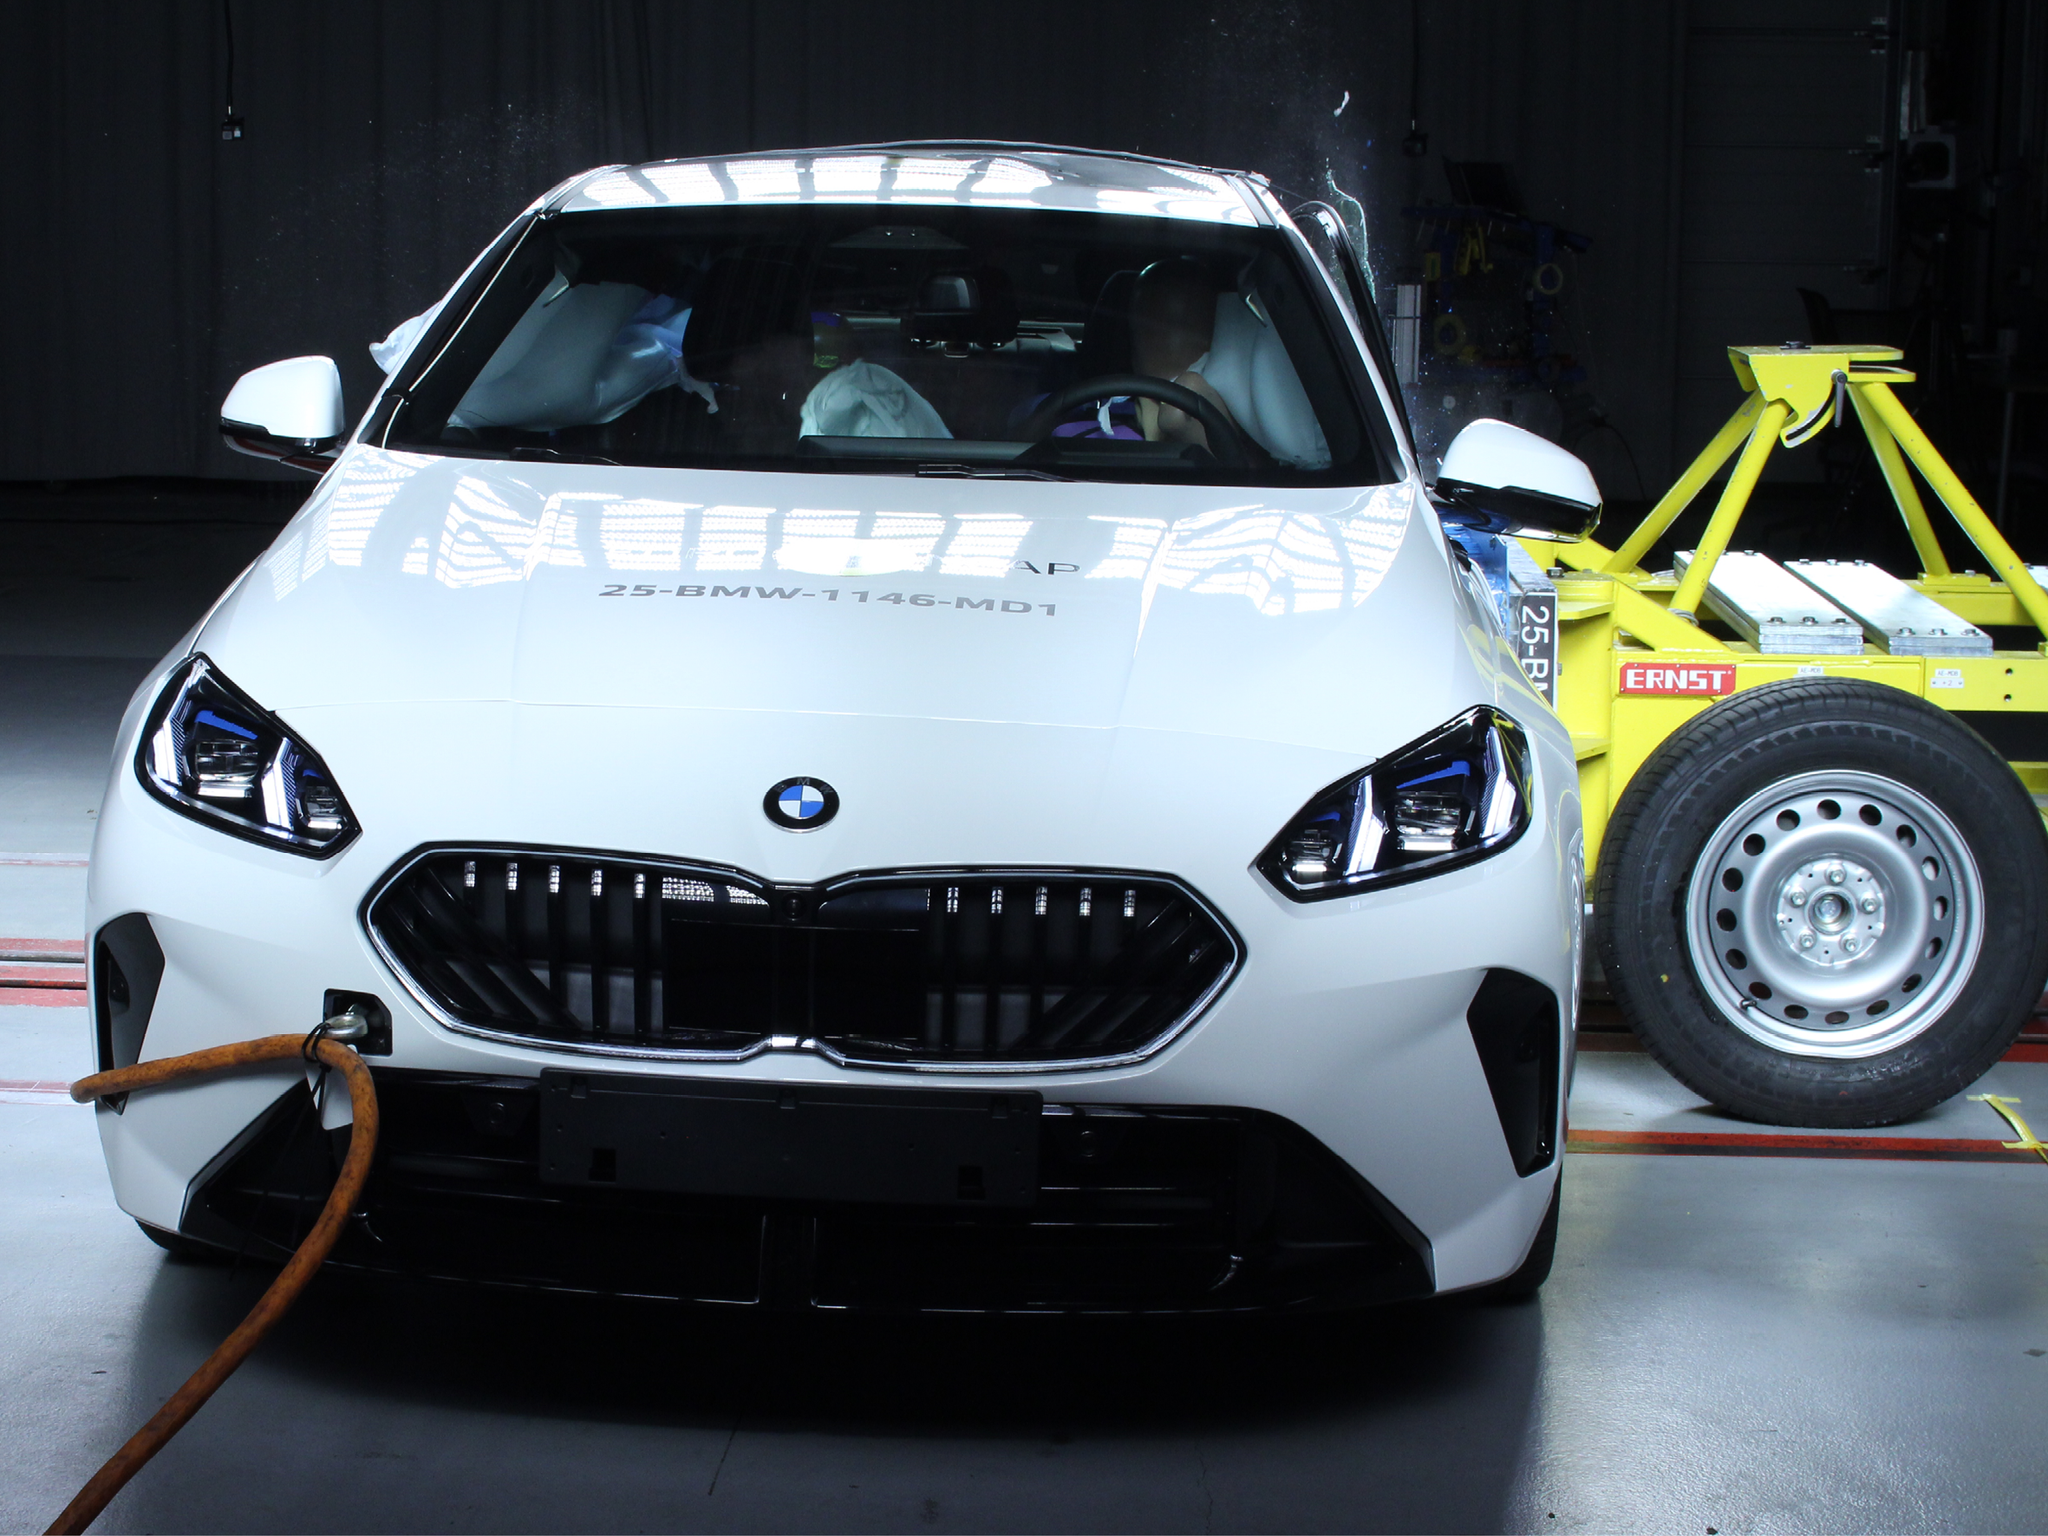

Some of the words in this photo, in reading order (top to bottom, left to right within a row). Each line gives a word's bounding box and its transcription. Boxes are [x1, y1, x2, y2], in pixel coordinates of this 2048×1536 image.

[598, 583, 1057, 617] 25-BMW-1146-MD1
[1520, 605, 1550, 692] 25-B
[1625, 668, 1727, 691] ERNST
[772, 777, 834, 794] BMW
